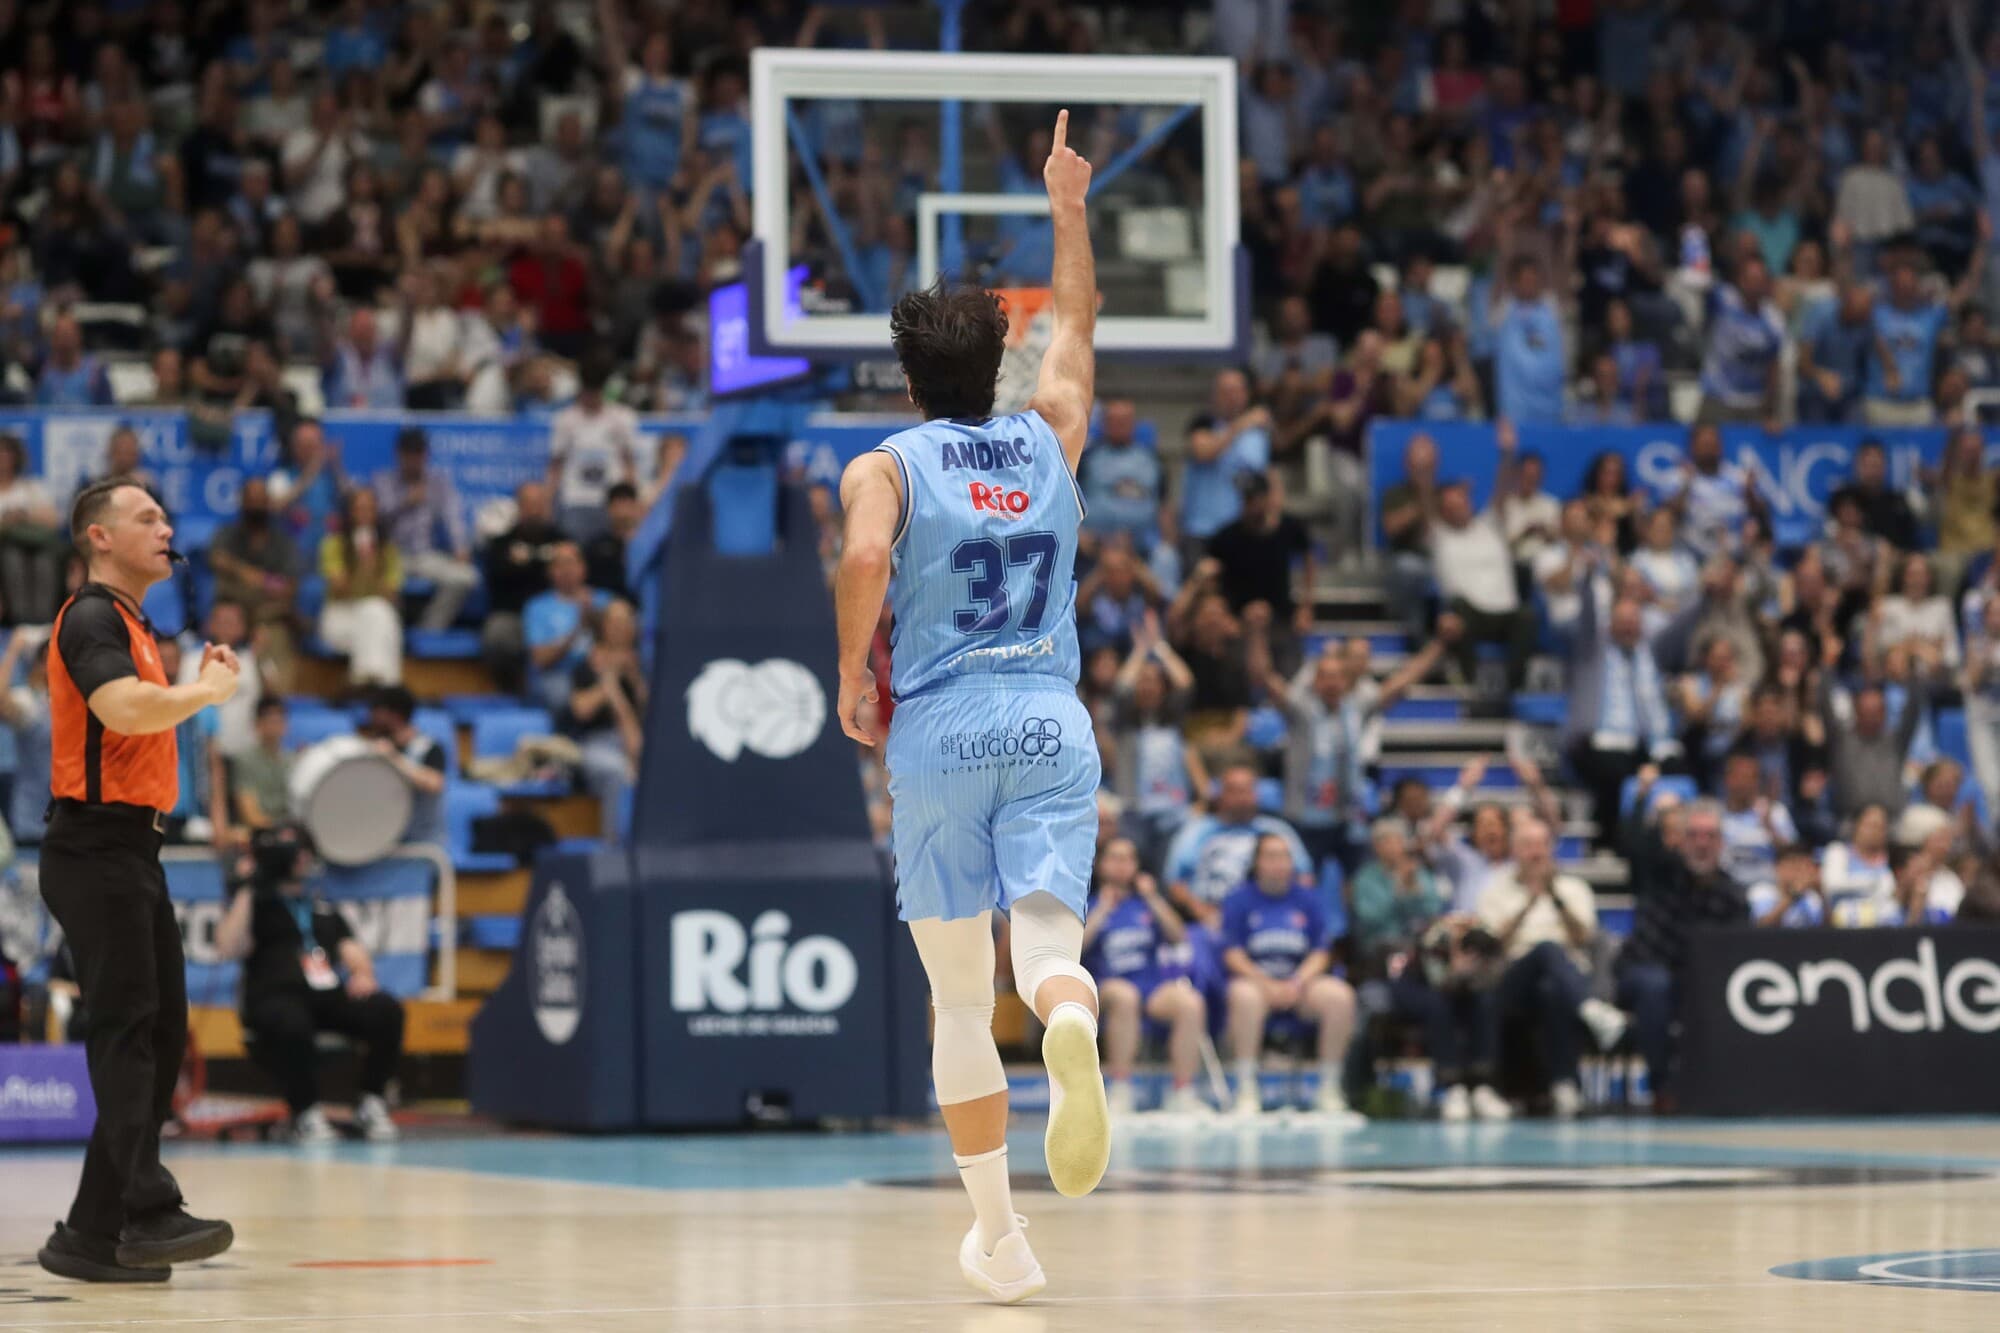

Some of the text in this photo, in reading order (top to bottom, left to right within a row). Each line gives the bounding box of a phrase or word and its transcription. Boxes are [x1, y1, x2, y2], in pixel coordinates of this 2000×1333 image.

[942, 437, 1033, 471] ANDRIC
[951, 531, 1060, 636] 37
[941, 737, 1018, 760] DE LUGO
[669, 908, 859, 1013] Río
[1726, 937, 2000, 1034] ende
